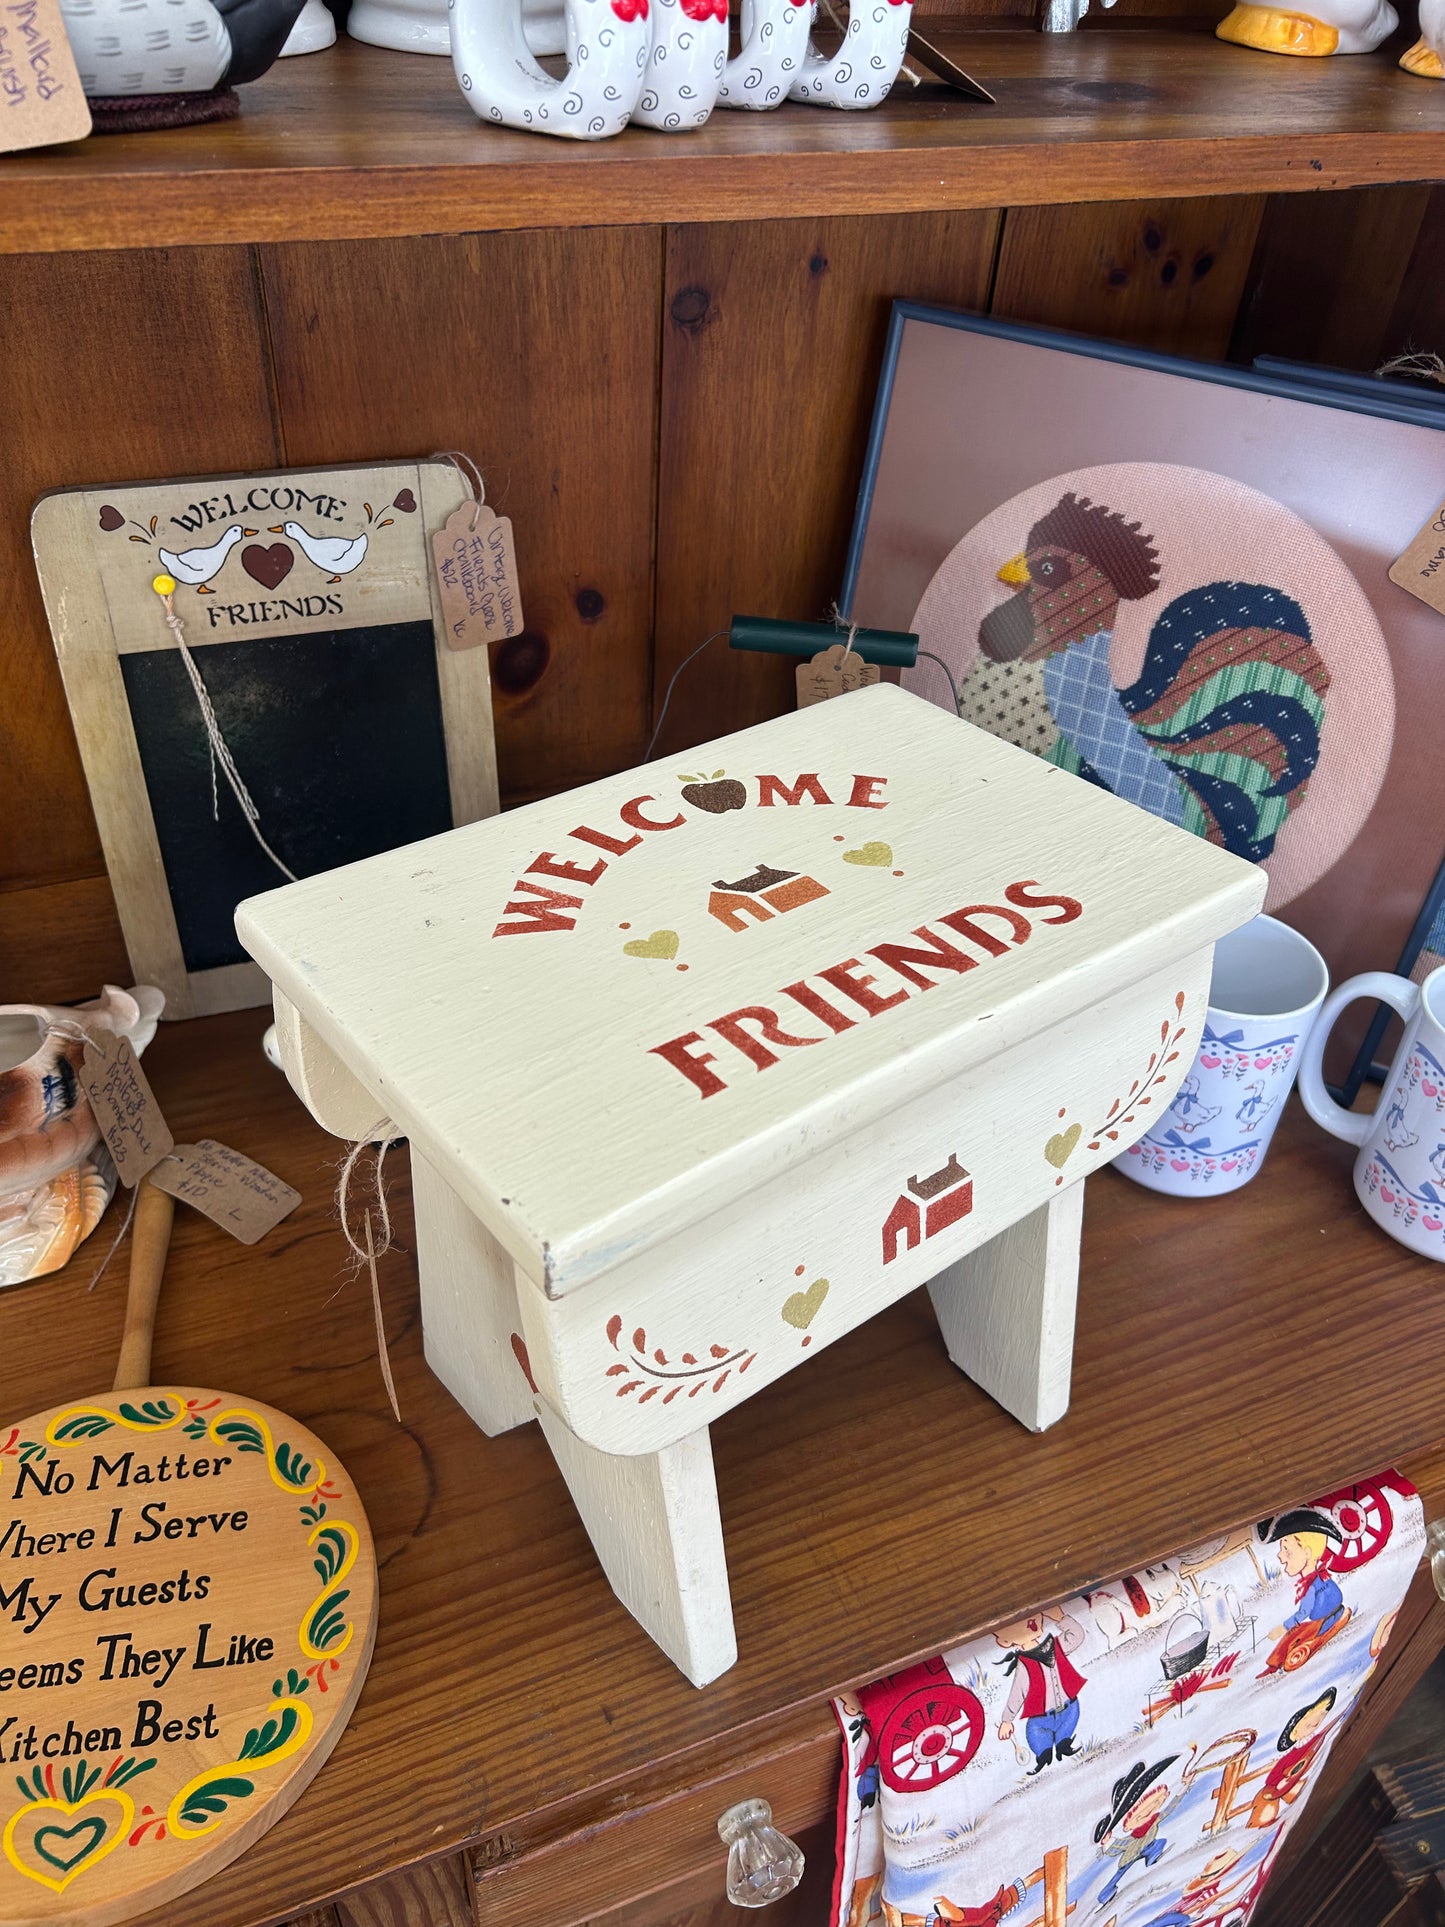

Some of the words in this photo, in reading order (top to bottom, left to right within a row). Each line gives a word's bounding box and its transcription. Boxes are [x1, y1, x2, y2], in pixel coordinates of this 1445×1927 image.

[170, 487, 348, 534] WELCOME
[206, 593, 345, 628] FRIENDS
[809, 674, 834, 700] $17
[646, 879, 1084, 1101] FRIENDS
[12, 1458, 75, 1500] No
[87, 1452, 233, 1491] Matter
[104, 1507, 124, 1548] I
[133, 1502, 250, 1545] Serve
[0, 1577, 63, 1634] My
[78, 1567, 212, 1612] Guests
[96, 1632, 187, 1689] They
[192, 1623, 275, 1670] Like
[130, 1699, 220, 1748] Best
